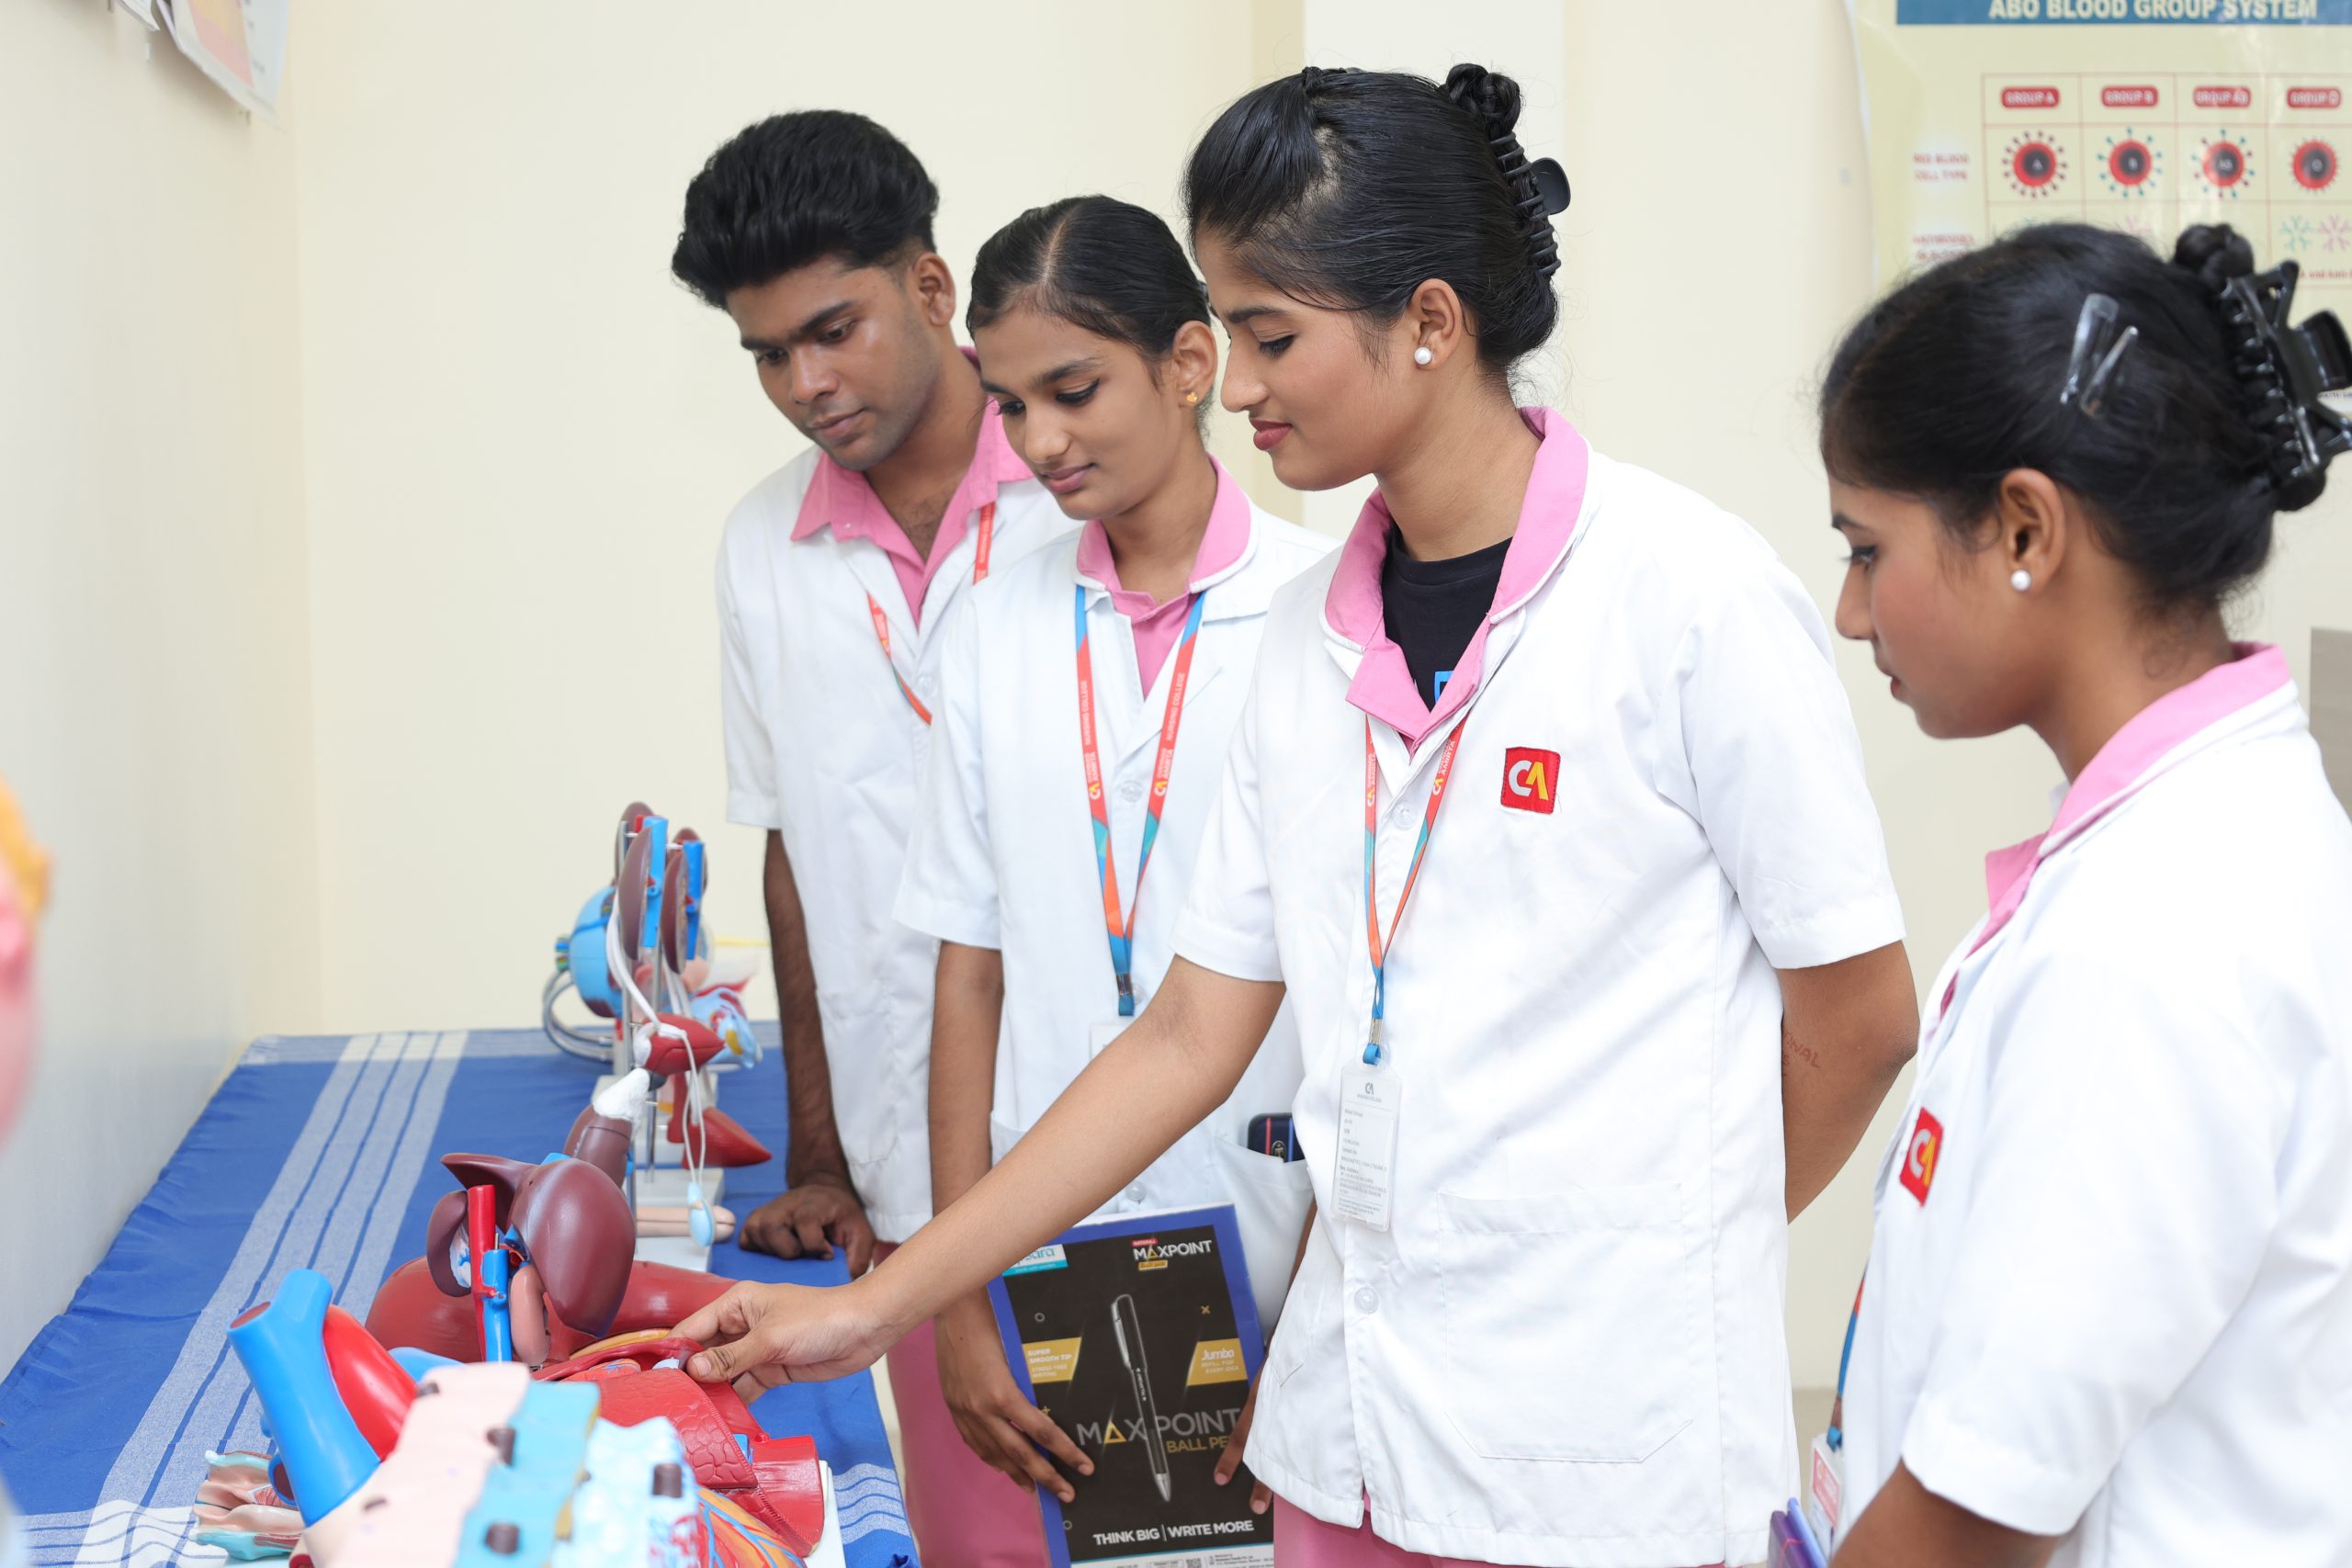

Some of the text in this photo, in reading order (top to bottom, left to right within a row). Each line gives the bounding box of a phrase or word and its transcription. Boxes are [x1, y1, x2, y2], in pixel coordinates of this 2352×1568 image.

[1989, 0, 2317, 19] ABO BLOOD GROUP SYSTEM
[2007, 92, 2055, 104] GROUP A
[2106, 91, 2143, 103] GROUP
[2197, 91, 2232, 103] GROUP
[2290, 92, 2328, 104] GROUP
[1508, 760, 1549, 801] CA
[1909, 1128, 1937, 1188] CA
[1202, 1348, 1235, 1359] Jumbo
[1166, 1436, 1229, 1453] BALL PE
[1092, 1520, 1254, 1545] THINK BIG WRITE MORE
